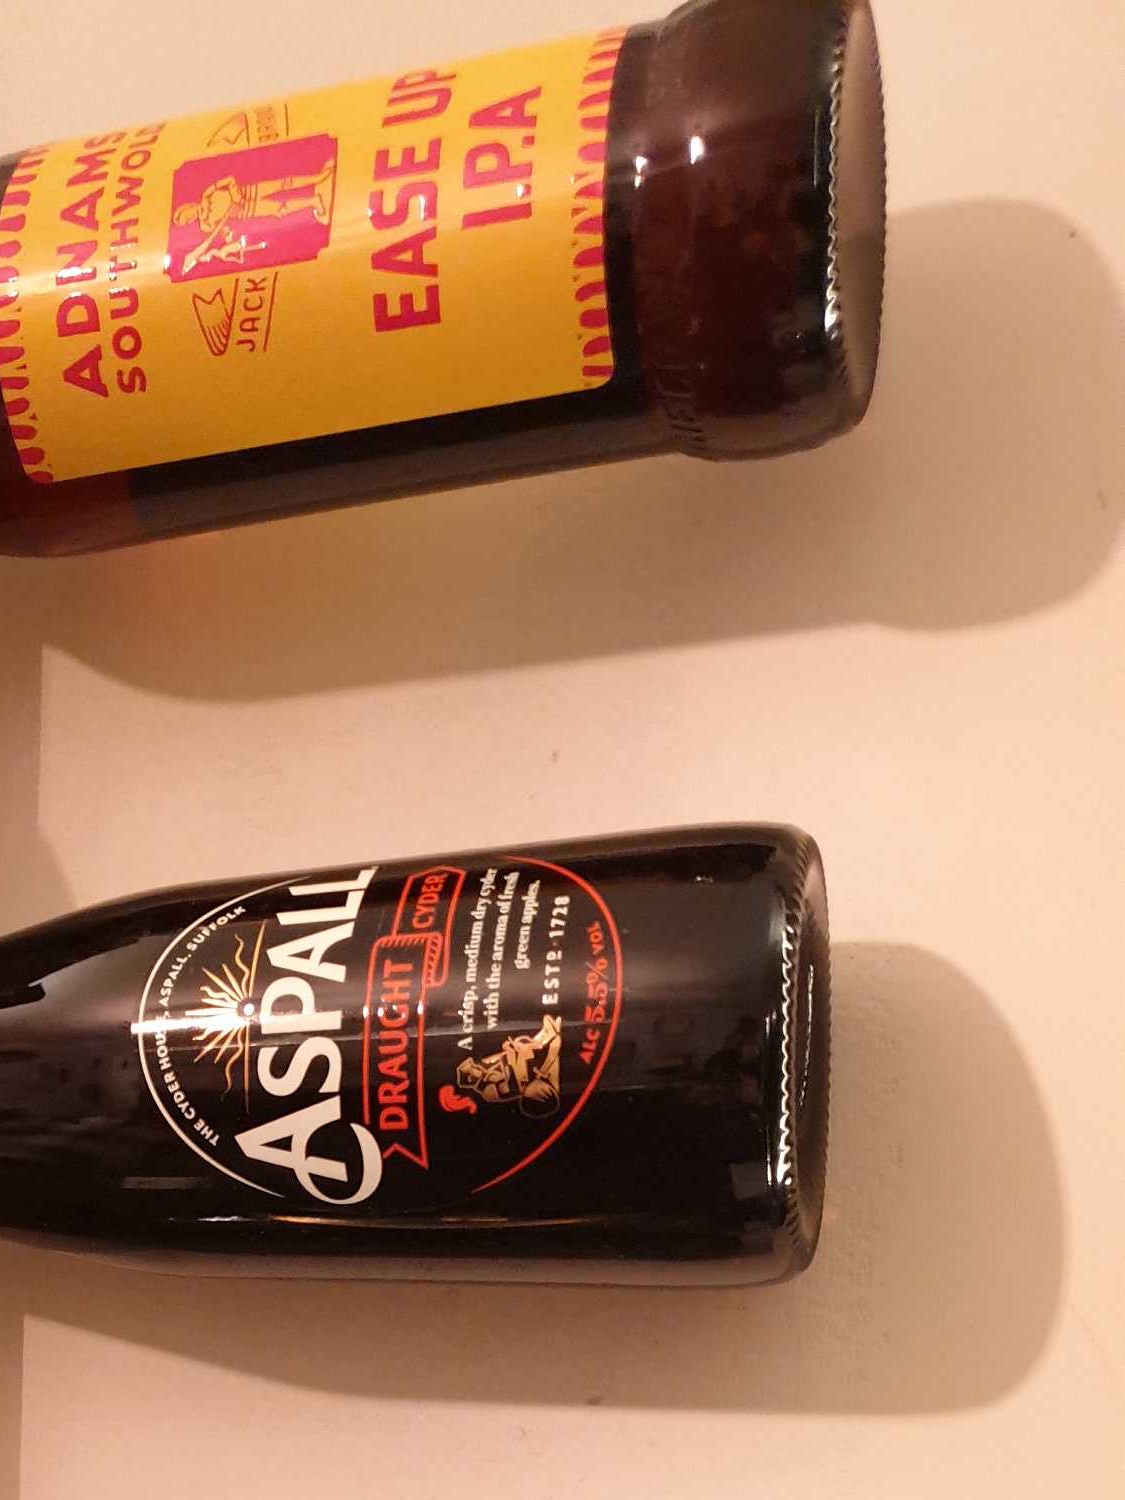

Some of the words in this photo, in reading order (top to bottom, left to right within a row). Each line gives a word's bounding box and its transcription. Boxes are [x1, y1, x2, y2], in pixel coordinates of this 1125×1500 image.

[381, 71, 456, 128] UP
[462, 86, 542, 230] I.P.A
[368, 138, 441, 332] EASE
[56, 131, 125, 397] ADNAMS
[236, 277, 266, 353] JACK
[413, 873, 446, 929] CYDER
[475, 868, 498, 896] cyder
[498, 872, 520, 899] fresh
[521, 880, 540, 923] apples.
[187, 906, 246, 951] SUFFOLK
[469, 897, 491, 920] dry
[496, 901, 511, 913] of
[547, 895, 570, 938] 1728
[463, 923, 482, 982] medium
[489, 914, 510, 961] aroma
[514, 926, 530, 969] green
[587, 922, 604, 955] VOL
[486, 963, 502, 989] the
[583, 958, 608, 1023] 5.5%
[458, 986, 478, 1033] crisp,
[484, 992, 500, 1029] with
[234, 866, 382, 1205] ASPALL
[377, 959, 413, 1130] DRAUGHT
[458, 1037, 473, 1050] A
[579, 1029, 599, 1064] ALC
[163, 1071, 197, 1119] CYDER
[194, 1119, 221, 1146] THE
